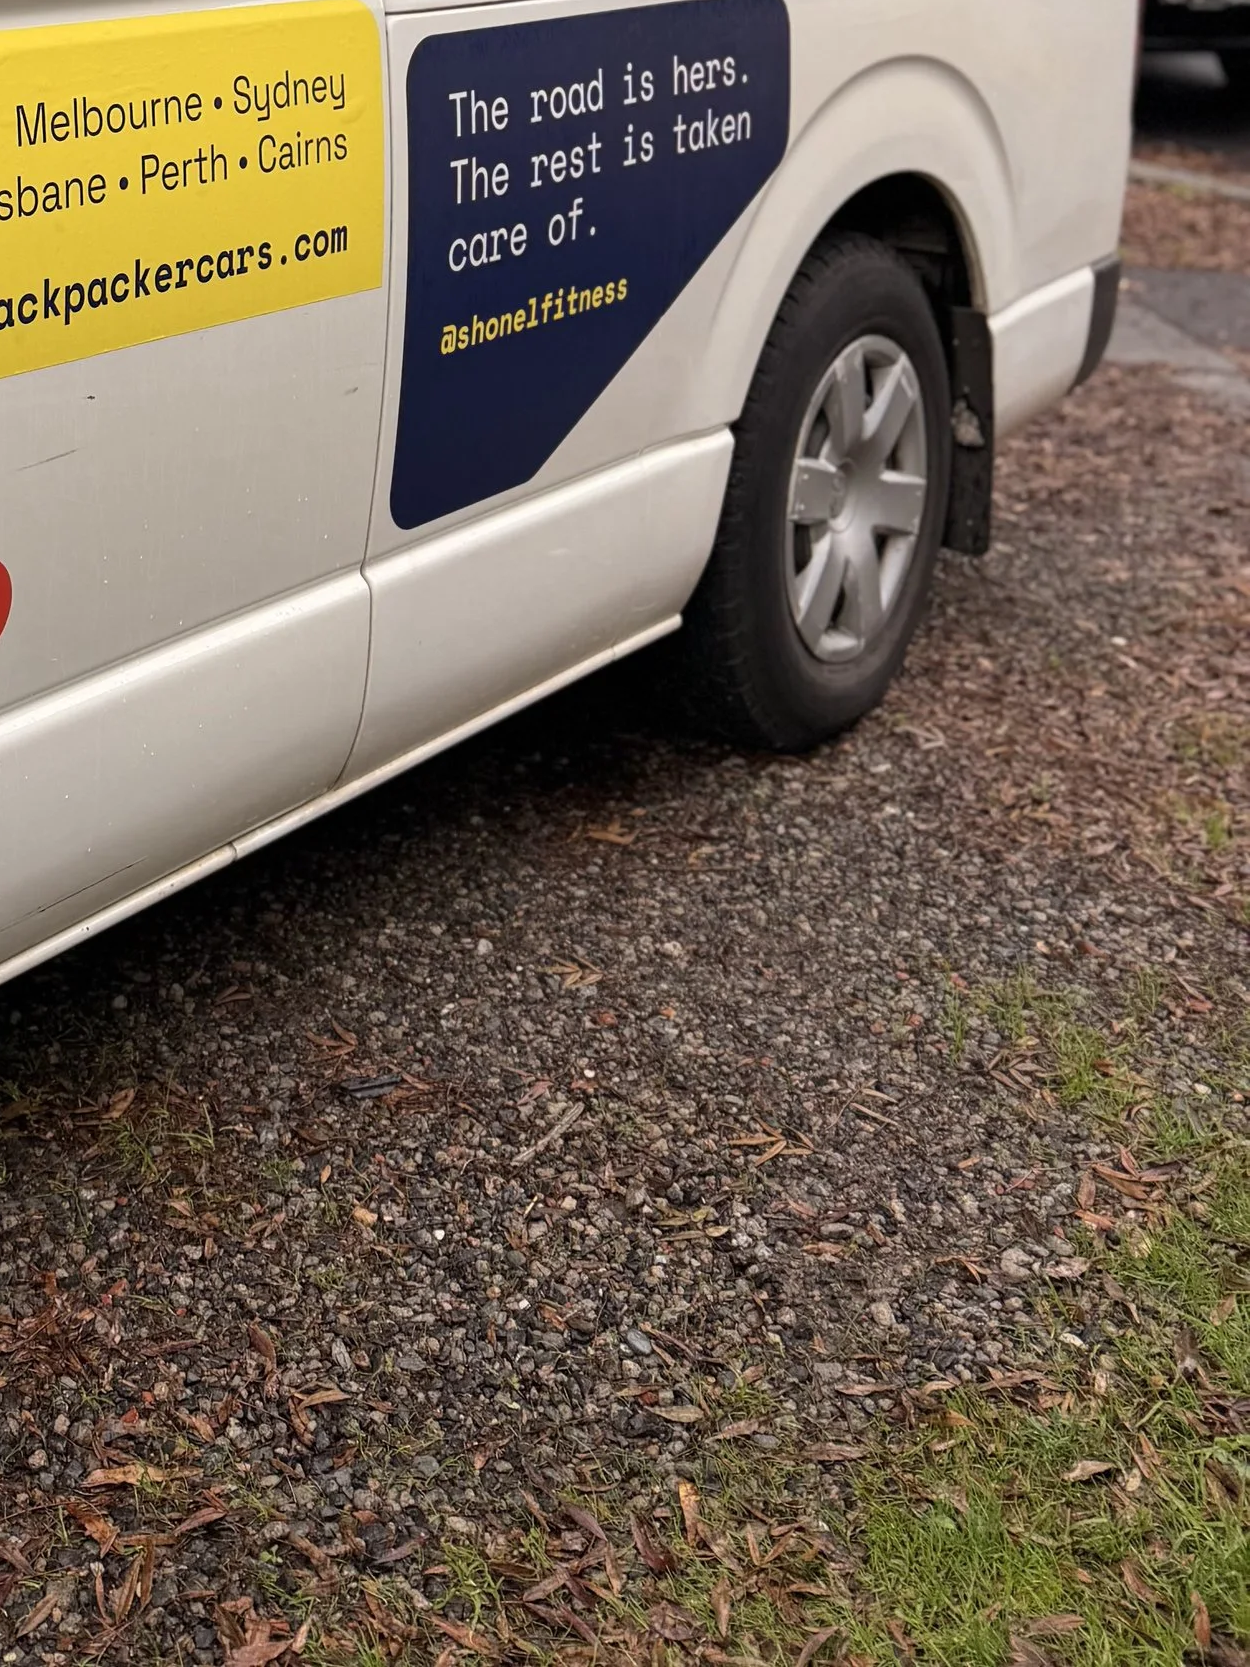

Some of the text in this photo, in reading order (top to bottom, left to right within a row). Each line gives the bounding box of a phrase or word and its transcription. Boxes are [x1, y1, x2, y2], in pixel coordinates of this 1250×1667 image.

[16, 70, 347, 147] Melbourne Sydney
[448, 54, 749, 138] The road is hers.
[139, 145, 229, 196] Perth
[257, 133, 349, 174] Cairns
[449, 108, 752, 205] The rest is taken
[447, 197, 597, 273] care of.
[440, 280, 628, 356] @shonelfitness
